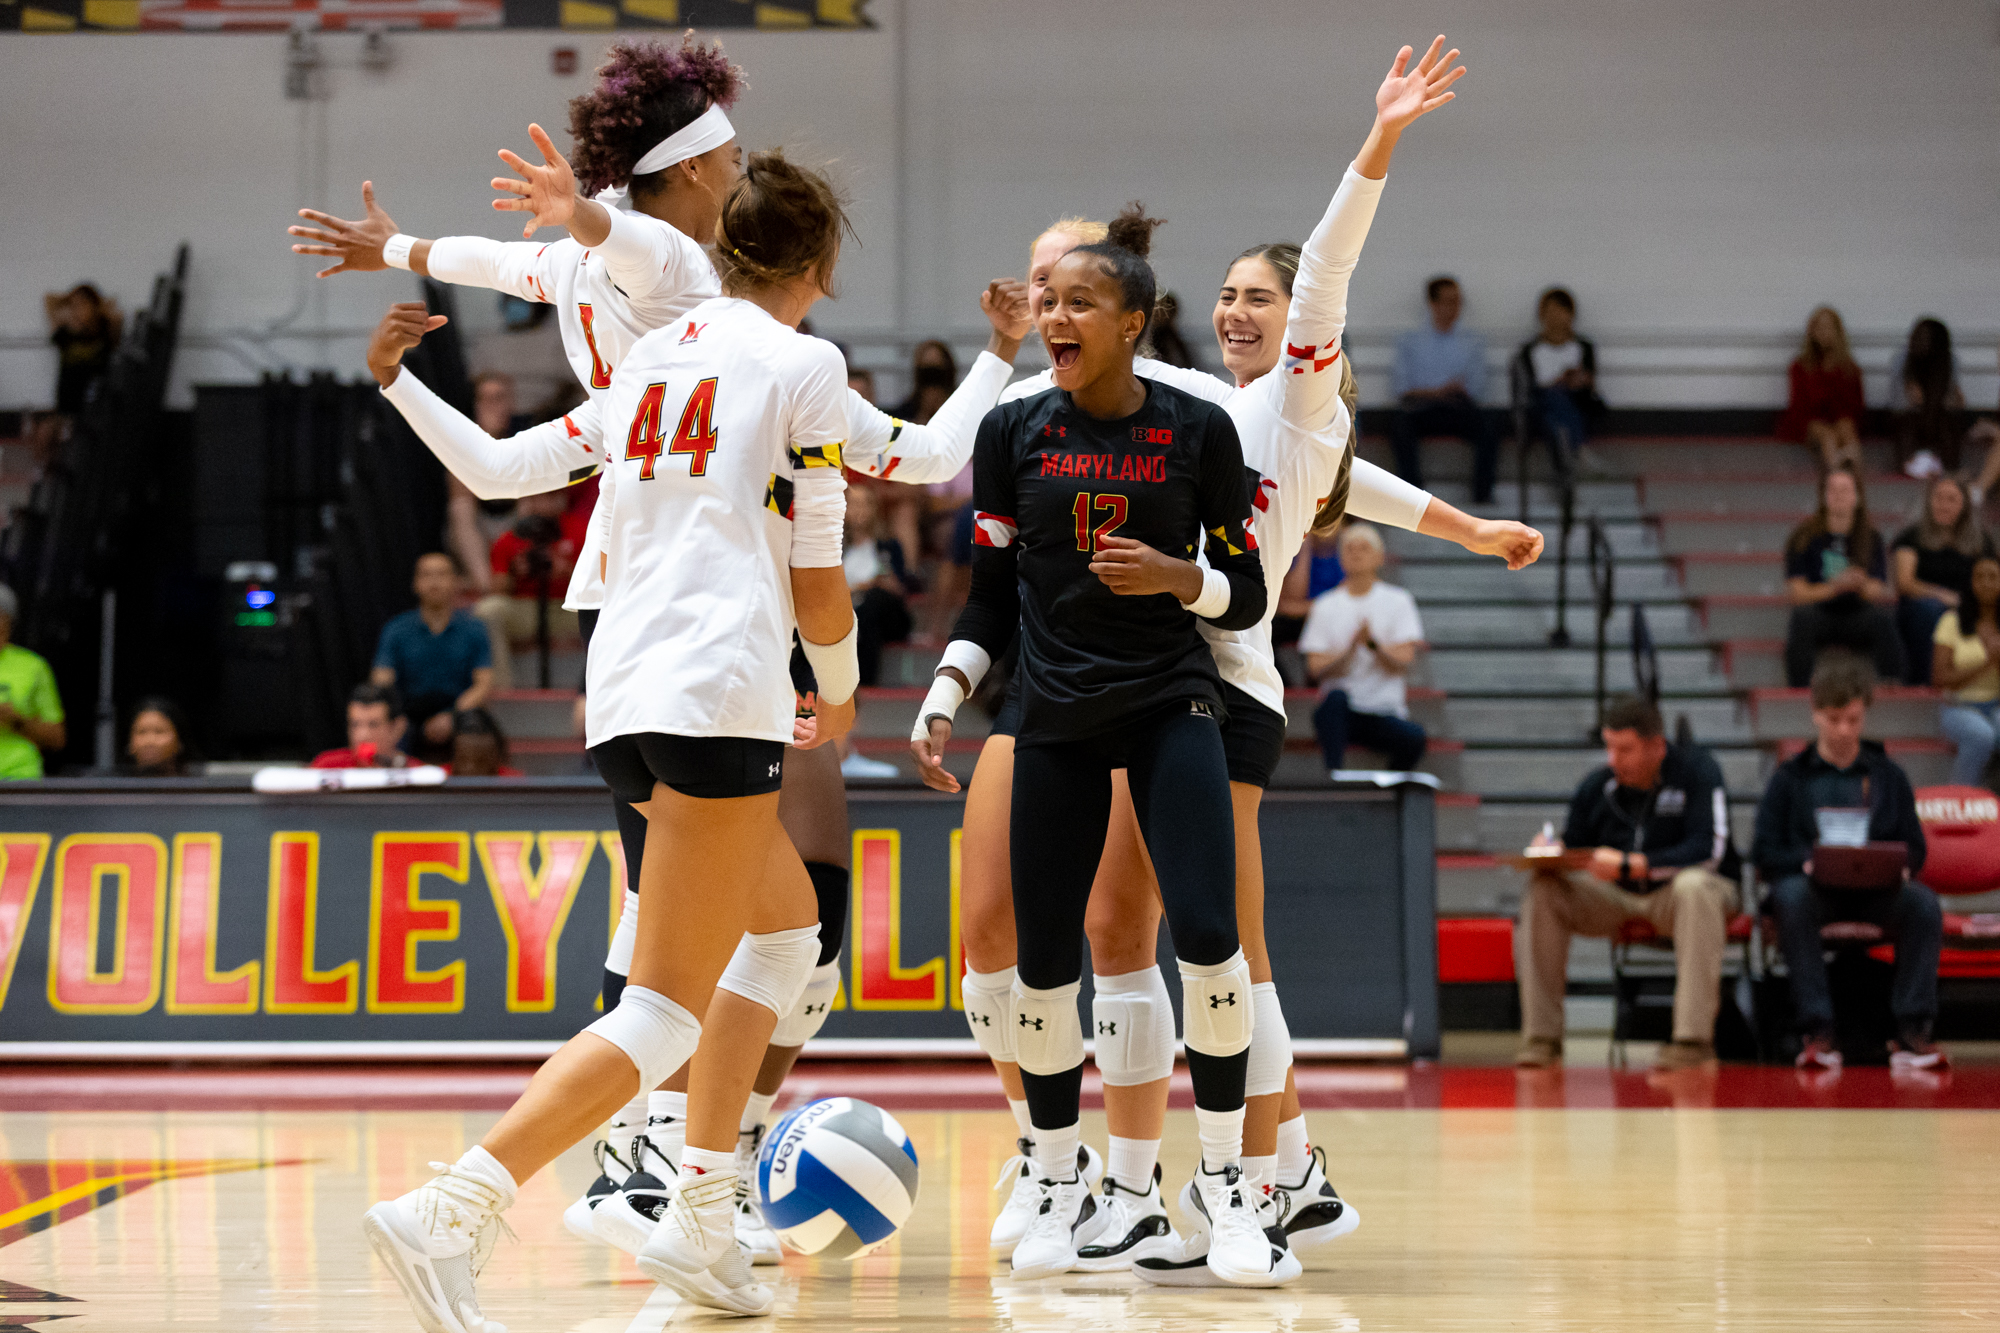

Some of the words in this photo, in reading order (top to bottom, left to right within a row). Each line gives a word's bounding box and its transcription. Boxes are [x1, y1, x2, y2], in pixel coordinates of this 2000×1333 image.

[625, 376, 718, 481] 44
[1040, 453, 1166, 483] MARYLAND
[1072, 492, 1129, 553] 12
[0, 829, 966, 1014] OLLEYL
[774, 1102, 832, 1174] molten
